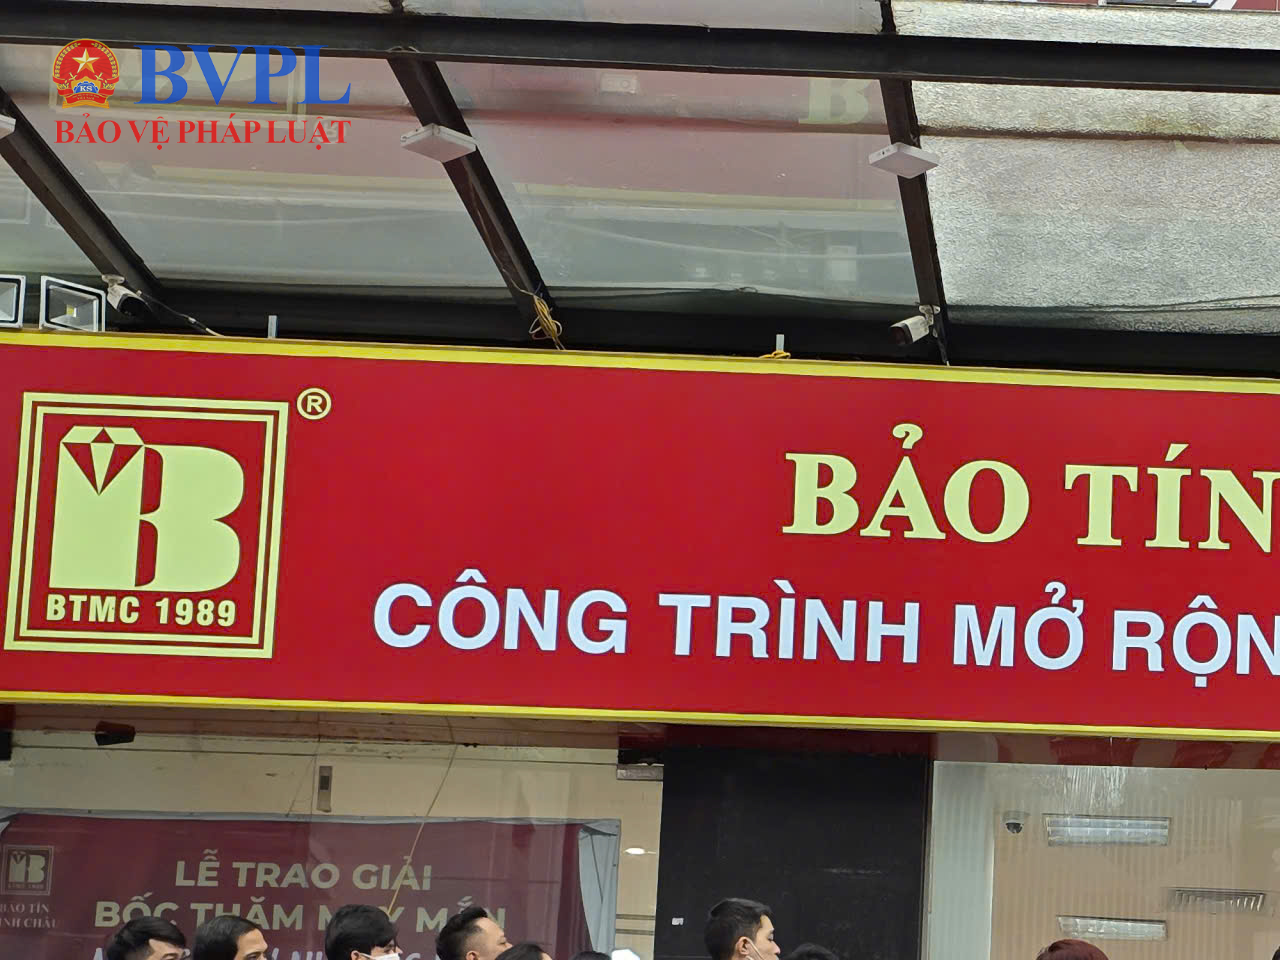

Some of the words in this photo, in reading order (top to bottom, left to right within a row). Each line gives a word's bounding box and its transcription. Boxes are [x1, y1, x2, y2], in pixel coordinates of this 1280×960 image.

[782, 423, 1030, 543] BẢO
[46, 593, 140, 624] BTMC
[155, 596, 237, 627] 1989
[373, 568, 628, 655] CÔNG
[658, 579, 920, 663] TRÌNH
[952, 581, 1085, 670] MỞ
[175, 848, 220, 887] LỄ
[232, 861, 340, 890] TRAO
[352, 856, 432, 891] GIẢI
